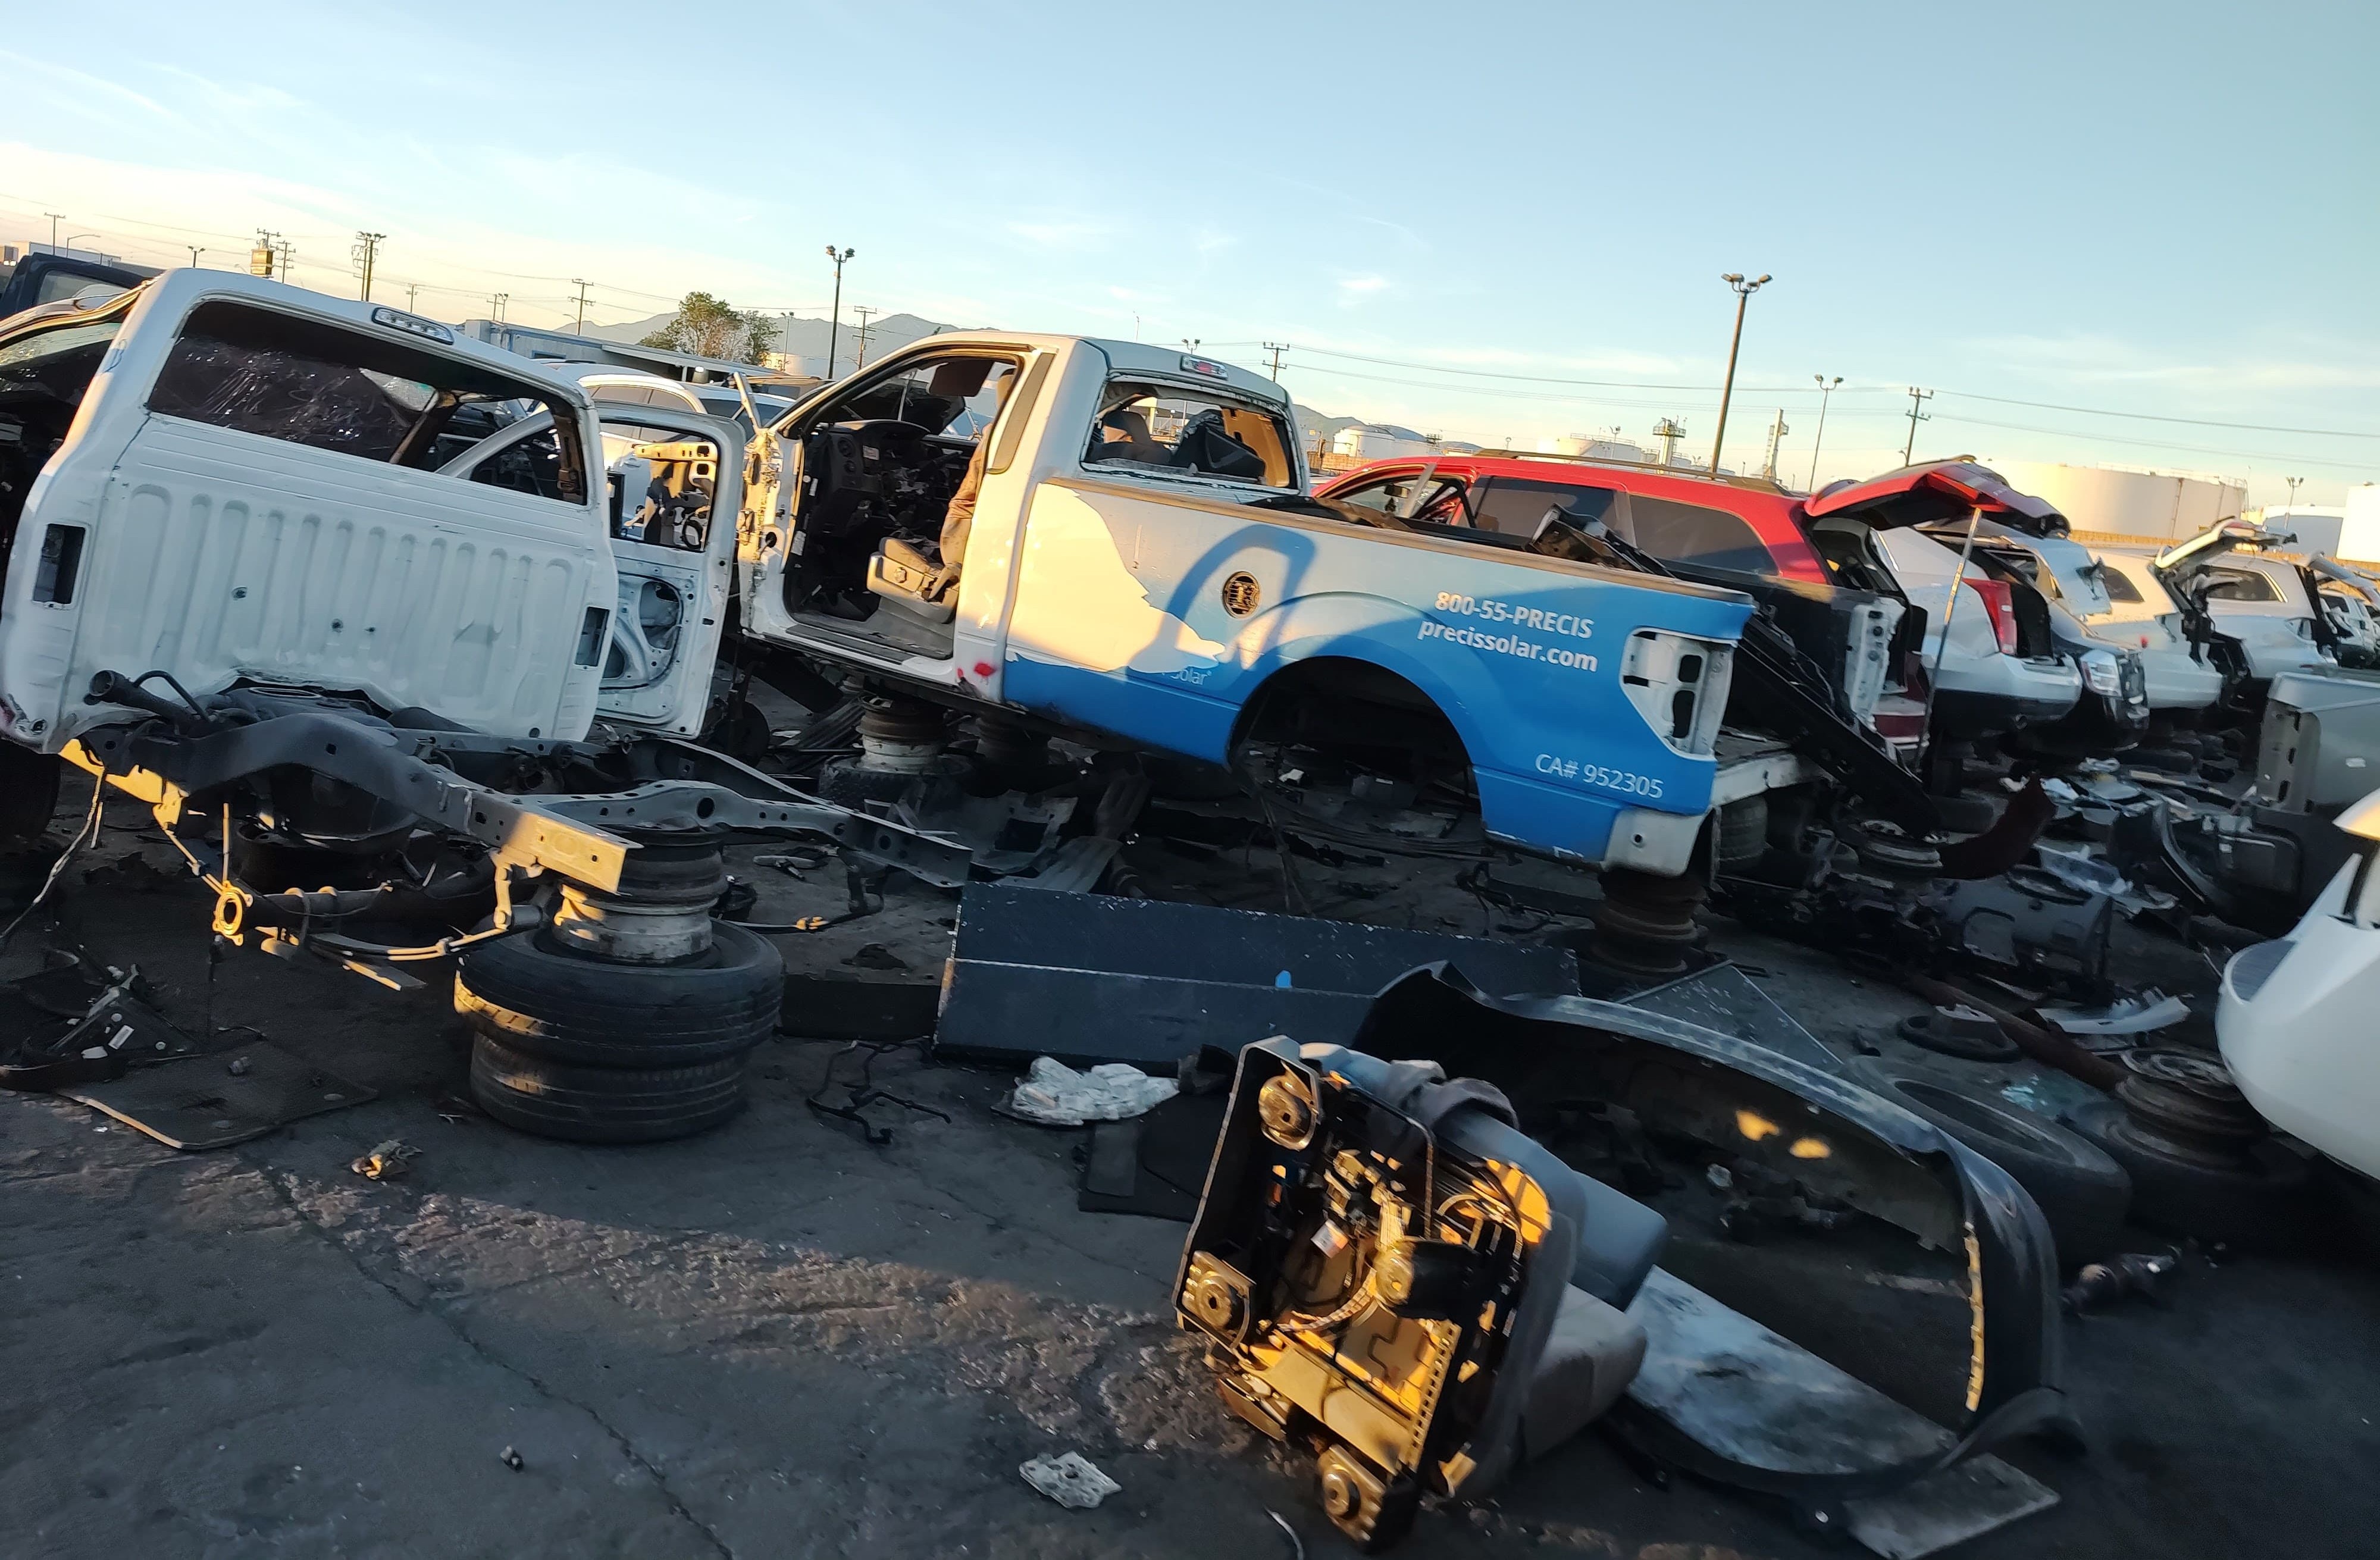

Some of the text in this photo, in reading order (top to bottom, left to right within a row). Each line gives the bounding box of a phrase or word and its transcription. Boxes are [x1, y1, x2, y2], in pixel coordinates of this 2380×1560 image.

[1435, 591, 1595, 638] 800-55-PRECIS
[1417, 621, 1598, 672] precissolar.com
[1535, 754, 1664, 798] CA# 952305
